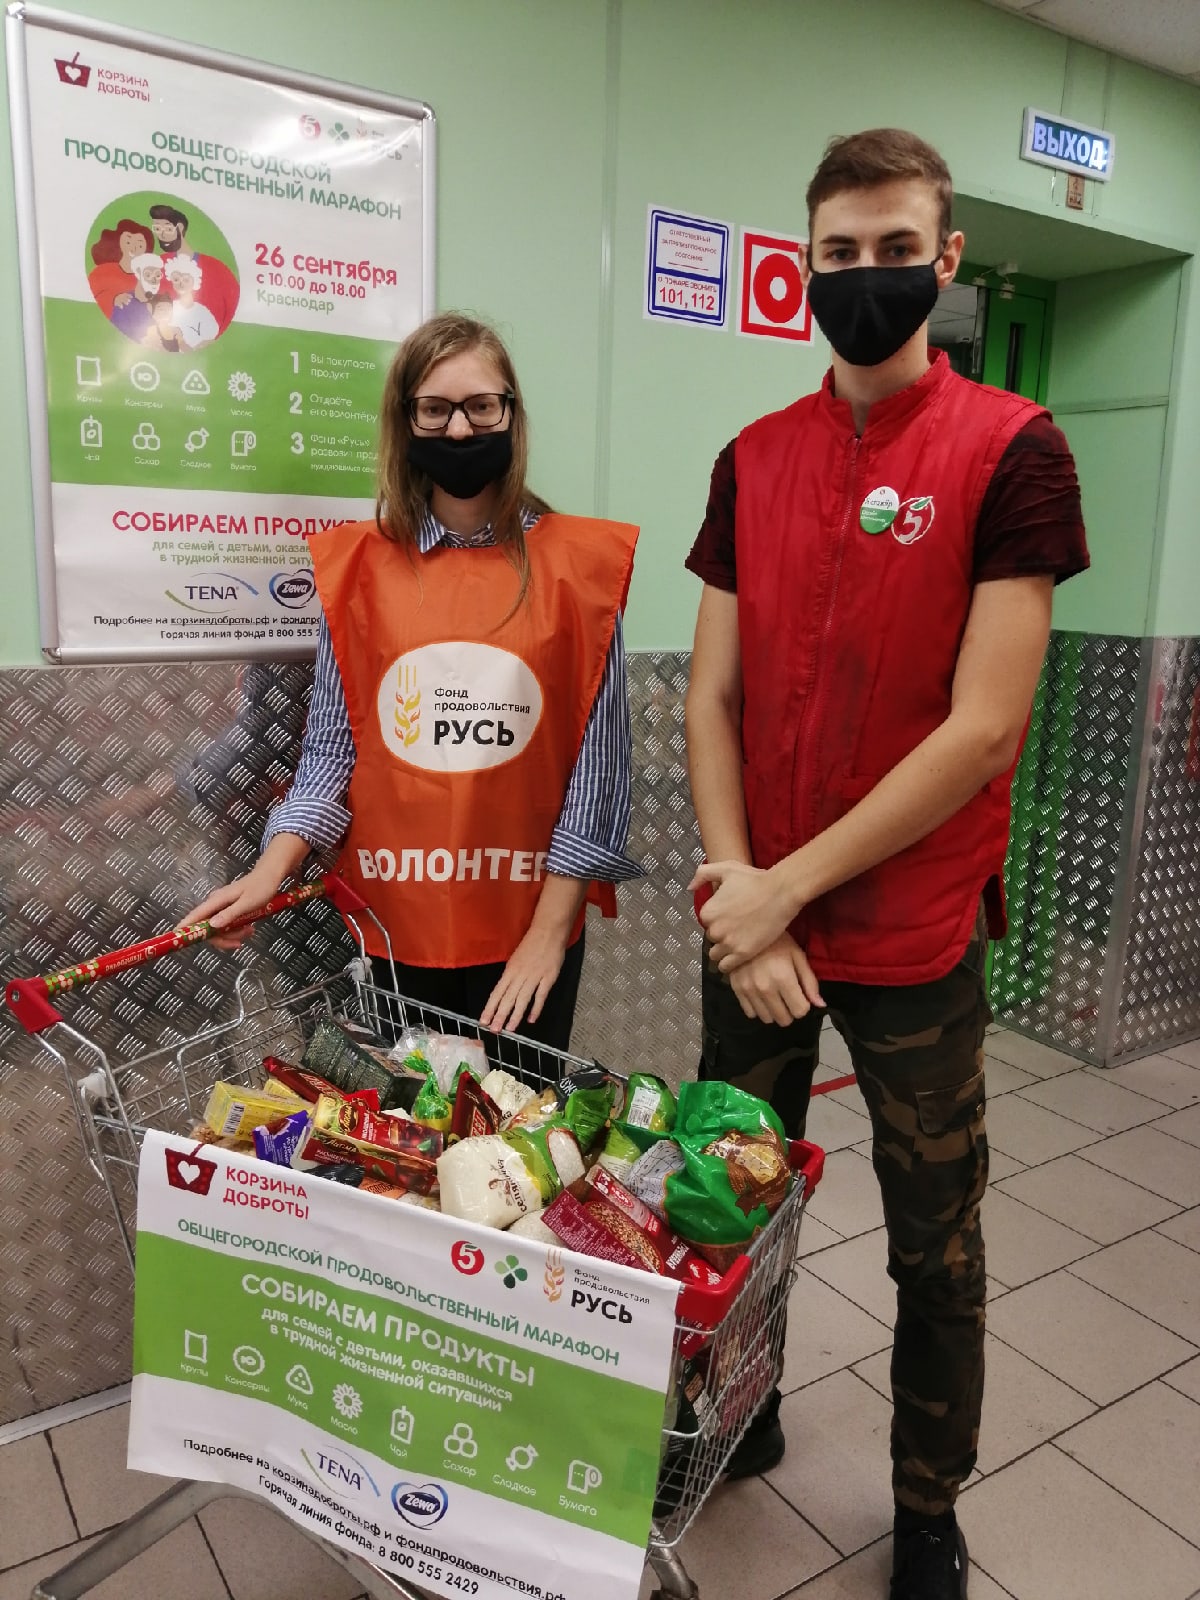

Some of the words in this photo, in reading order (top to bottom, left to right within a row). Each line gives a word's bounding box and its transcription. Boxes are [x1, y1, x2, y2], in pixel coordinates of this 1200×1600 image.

[97, 69, 149, 87] КОРЗИНА
[97, 82, 150, 102] ДОБРОТЫ
[152, 131, 331, 184] ОБЩЕГОРОДСКОЙ
[1034, 123, 1105, 170] ВЫХОД
[65, 138, 303, 201] ПРОДОВОЛЬСТВЕННЫЙ
[310, 188, 401, 220] МАРАФОН
[255, 243, 284, 268] 26
[293, 254, 397, 288] сентября
[256, 273, 264, 284] с
[268, 272, 305, 290] 10.00
[309, 282, 327, 294] до
[331, 282, 365, 298] 18.00
[256, 289, 334, 315] Краснодар
[691, 293, 715, 311] 112
[290, 351, 299, 374] 1
[310, 353, 324, 364] Вы
[289, 391, 303, 415] 2
[290, 432, 305, 455] 3
[112, 510, 248, 534] СОБИРАЕМ
[152, 541, 174, 551] для
[178, 540, 215, 551] семей
[218, 543, 224, 551] с
[226, 543, 272, 553] детьми,
[159, 554, 167, 562] в
[171, 553, 220, 565] трудной
[222, 555, 286, 564] жизненной
[289, 557, 313, 566] ситу
[184, 585, 238, 600] TENA
[281, 583, 308, 593] Zewa
[93, 615, 152, 627] Подробнее
[170, 615, 270, 626] корзинадоброты.рф
[160, 630, 200, 640] Горячая
[233, 629, 266, 640] фонда
[268, 629, 273, 637] 8
[276, 629, 294, 637] 800
[296, 628, 313, 637] 555
[434, 687, 468, 699] Фонд
[434, 701, 531, 715] продовольствия
[434, 719, 515, 746] РУСЬ
[226, 1166, 307, 1199] КОРЗИНА
[223, 1188, 309, 1219] ДОБРОТЫ
[574, 1268, 600, 1282] Фонд
[178, 1219, 322, 1267] ОБЩЕГОРОДСКОЙ
[327, 1256, 519, 1334] ПРОДОВОЛЬСТВЕННЫЙ
[523, 1323, 619, 1366] МАРАФОН
[574, 1277, 650, 1304] продовольствия
[571, 1289, 632, 1324] РУСЬ
[242, 1274, 376, 1334] СОБИРАЕМ
[384, 1315, 535, 1386] ПРОДУКТЫ
[261, 1308, 288, 1323] для
[292, 1316, 333, 1341] семей
[335, 1335, 344, 1347] с
[346, 1341, 406, 1370] детьми,
[411, 1359, 513, 1402] оказавшихся
[180, 1362, 209, 1377] Крупы
[270, 1324, 279, 1335] в
[283, 1326, 337, 1360] трудной
[340, 1352, 424, 1391] жизненной
[428, 1381, 502, 1412] ситуации
[224, 1374, 270, 1393] Консервы
[287, 1393, 309, 1411] Мука
[330, 1415, 359, 1436] Масло
[316, 1451, 362, 1491] TENA
[442, 1459, 477, 1478] Сахар
[183, 1439, 253, 1463] Подробнее
[256, 1457, 270, 1470] на
[272, 1464, 381, 1537] корзинадоброты.рф
[384, 1531, 392, 1541] и
[492, 1474, 537, 1497] Сладкое
[404, 1493, 437, 1513] Zewa
[558, 1495, 598, 1516] Бумага
[258, 1475, 297, 1507] Горячая
[298, 1502, 332, 1528] линия
[334, 1520, 375, 1552] фонда:
[378, 1546, 386, 1557] 8
[389, 1551, 415, 1569] 800
[417, 1560, 442, 1581] 555
[445, 1572, 480, 1596] 2429
